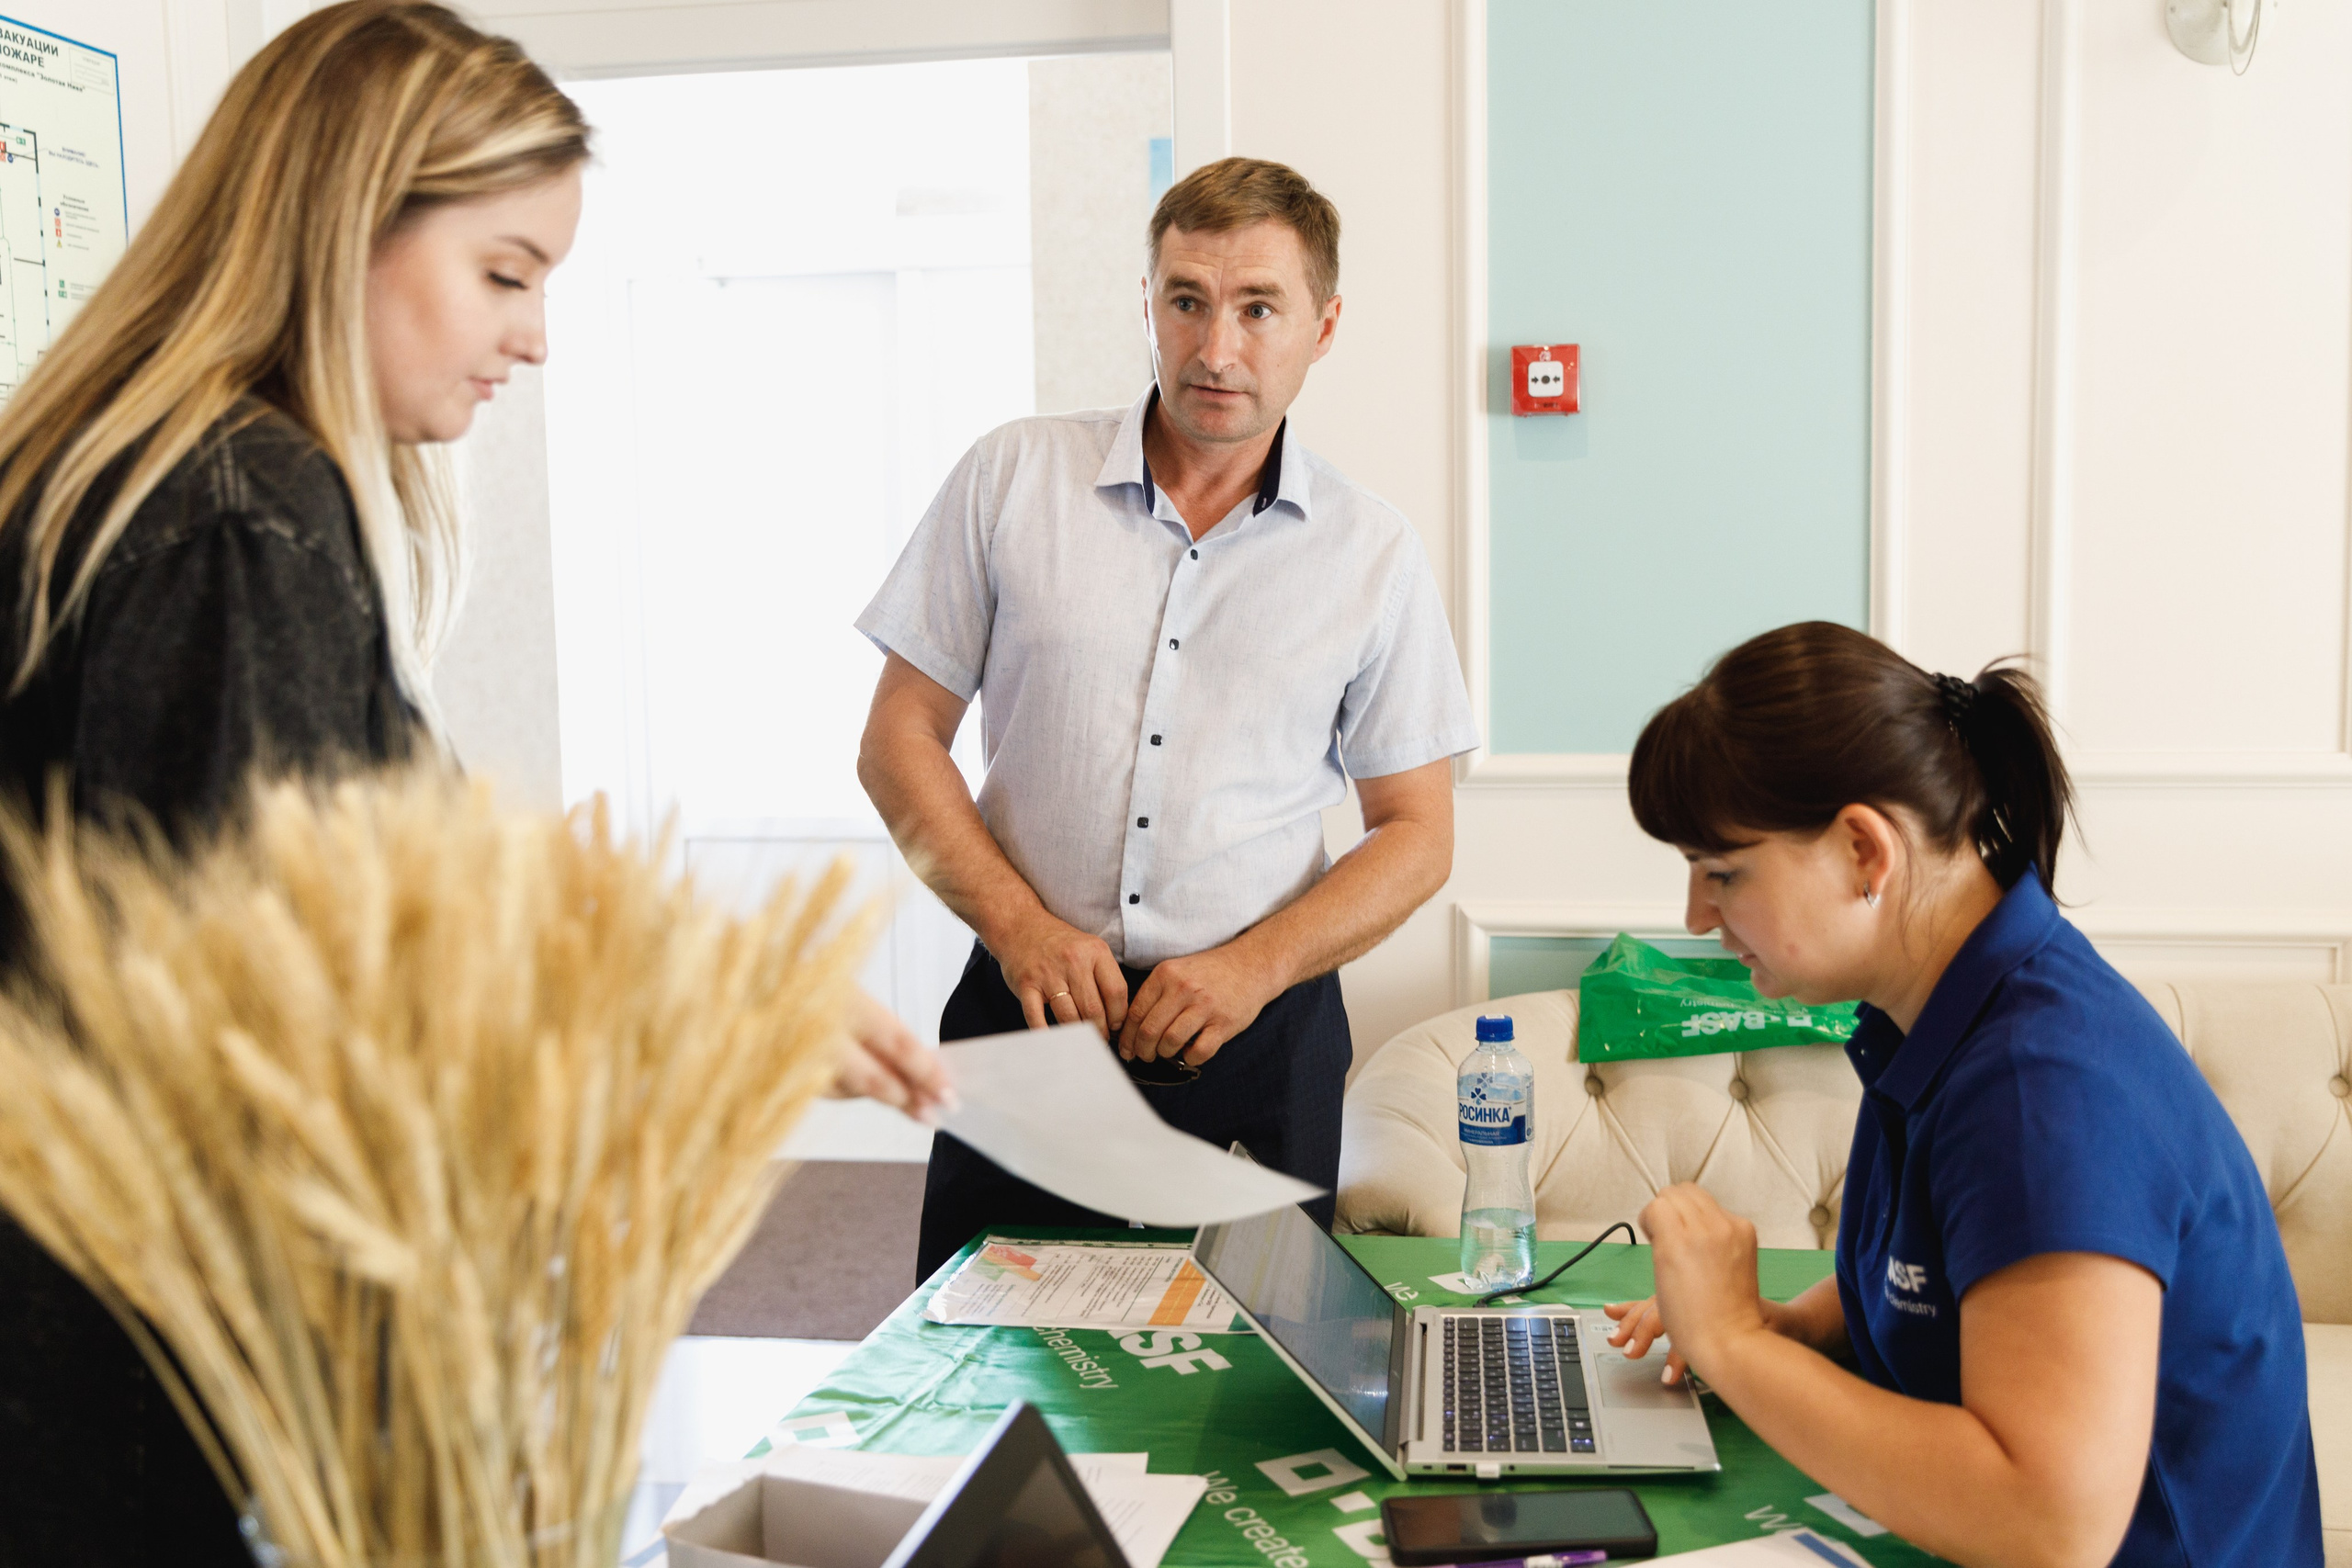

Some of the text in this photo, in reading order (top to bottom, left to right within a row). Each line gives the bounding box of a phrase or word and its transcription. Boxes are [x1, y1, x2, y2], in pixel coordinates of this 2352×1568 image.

[0, 62, 35, 77] омплекса
[1681, 1011, 1765, 1037] BASF
[1459, 1102, 1510, 1122] РОСИНКА
[1107, 1330, 1233, 1375] SF
[1744, 1505, 1803, 1531] W
[1224, 1506, 1309, 1568] create
